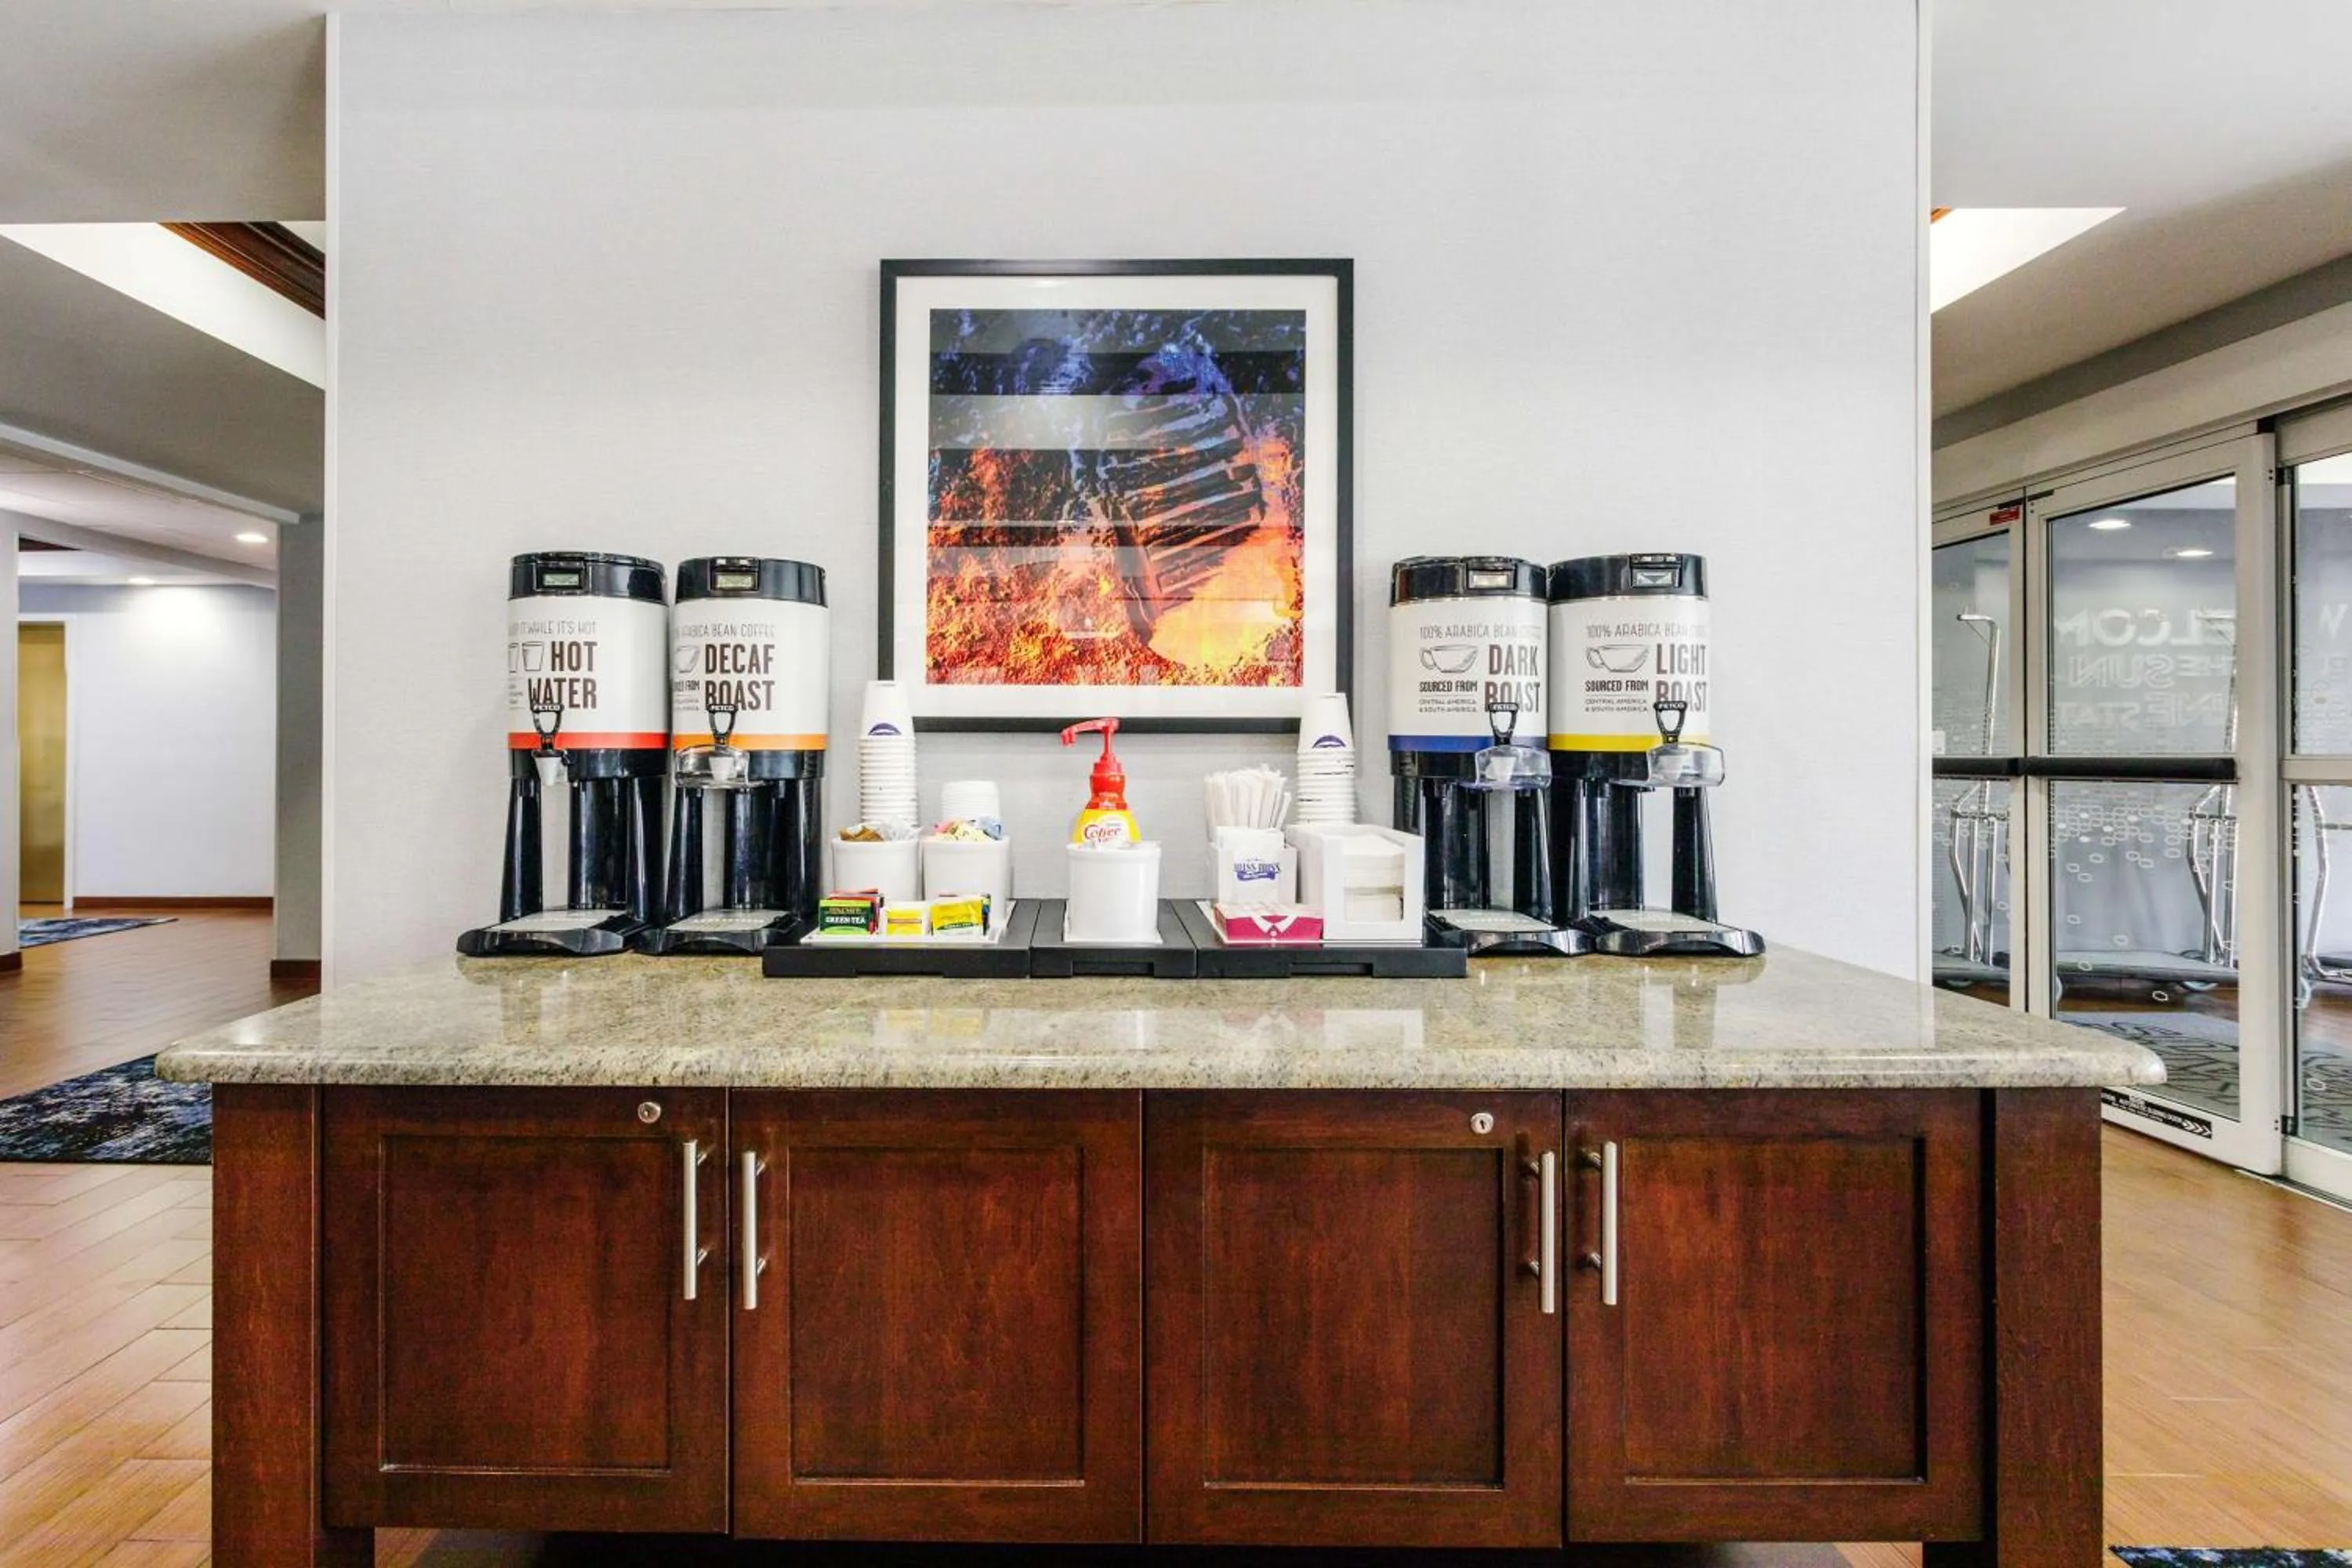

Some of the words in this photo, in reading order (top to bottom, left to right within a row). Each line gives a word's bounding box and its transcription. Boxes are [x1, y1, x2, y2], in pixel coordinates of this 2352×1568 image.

[1420, 626, 1443, 640] 100%
[1444, 624, 1490, 638] ARABICA
[1615, 623, 1661, 638] ARABICA
[551, 641, 597, 672] HOT
[705, 644, 775, 675] DECAF
[1489, 644, 1538, 677] DARK
[1656, 643, 1707, 676] LIGHT
[528, 677, 597, 709] WATER
[705, 680, 775, 711] ROAST
[1419, 681, 1453, 692] SOURCED
[1456, 680, 1478, 692] FROM
[1484, 681, 1541, 713] ROAST
[1584, 680, 1622, 692] SOURCED
[1625, 680, 1649, 692] FROM
[1656, 680, 1708, 713] ROAST
